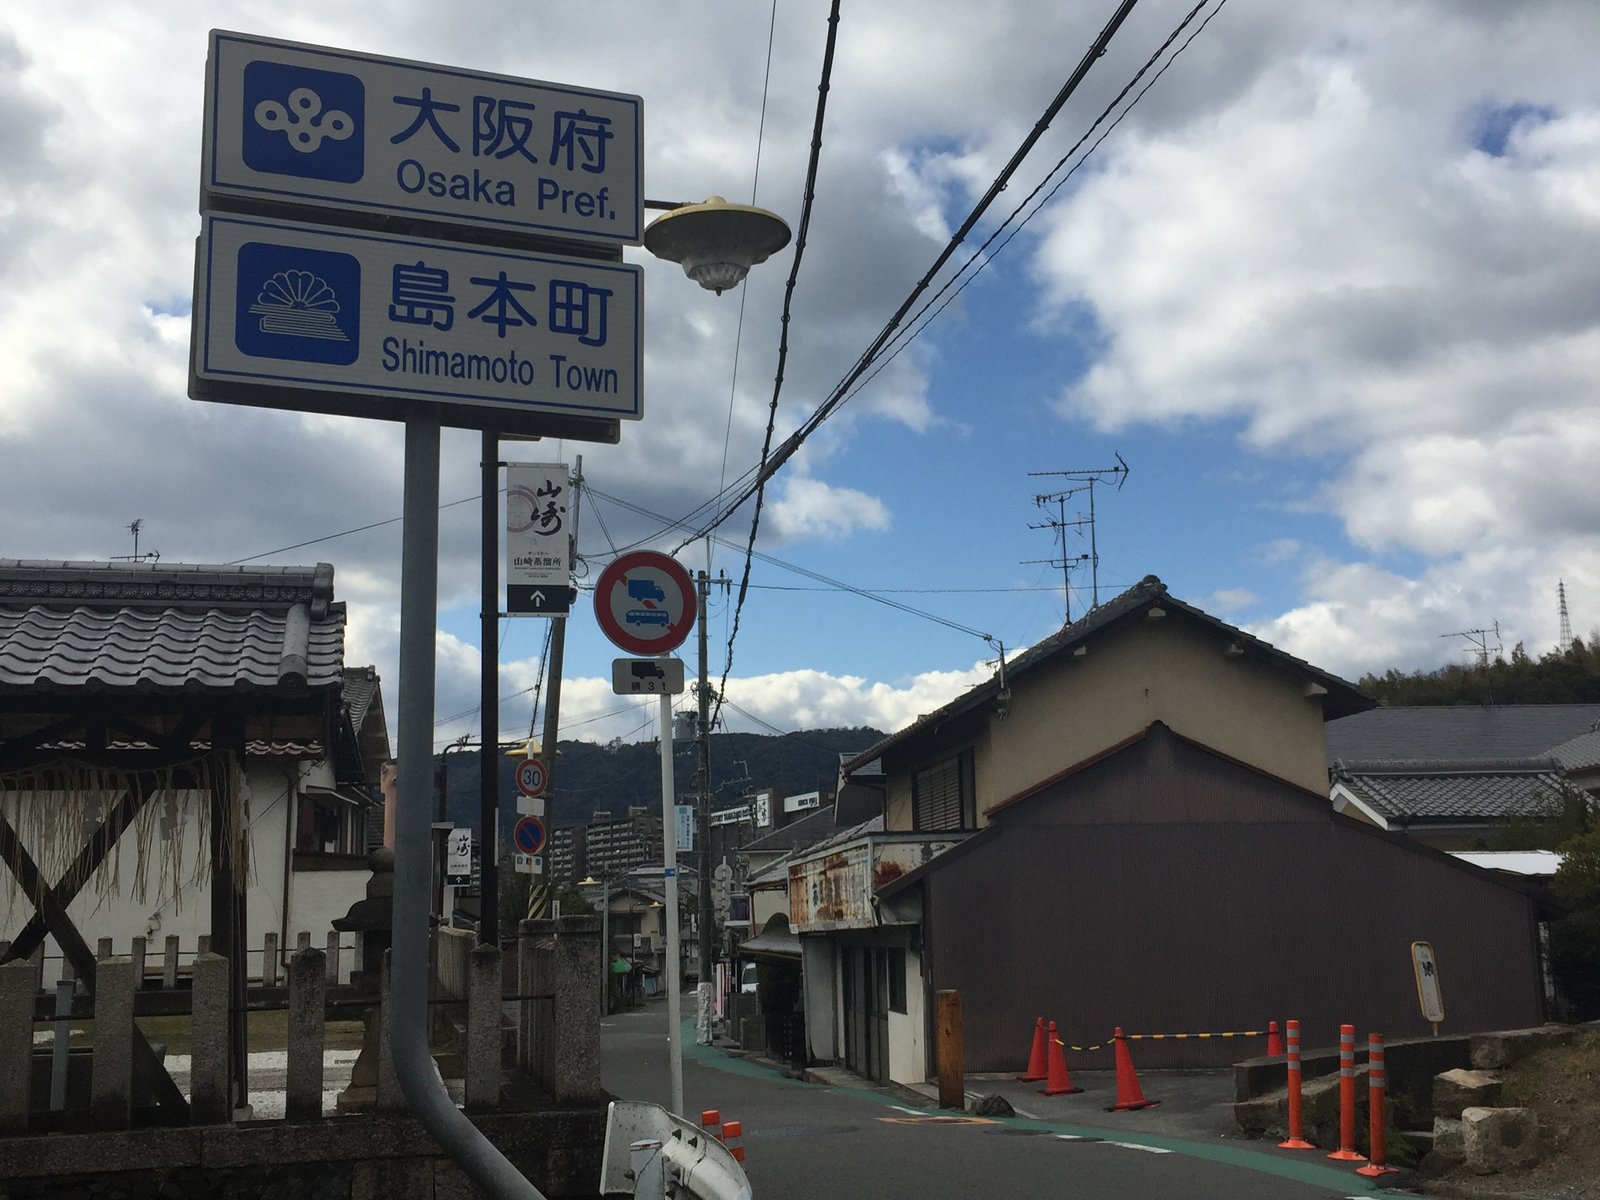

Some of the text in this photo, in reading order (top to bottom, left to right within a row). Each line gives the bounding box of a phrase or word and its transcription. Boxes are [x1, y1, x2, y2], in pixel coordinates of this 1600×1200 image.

[390, 86, 614, 174] 大阪府
[397, 159, 616, 220] Osaka Pref.
[388, 260, 614, 348] 島本町
[382, 336, 618, 394] Shimamoto Town
[648, 681, 655, 691] 3
[523, 769, 541, 786] 30
